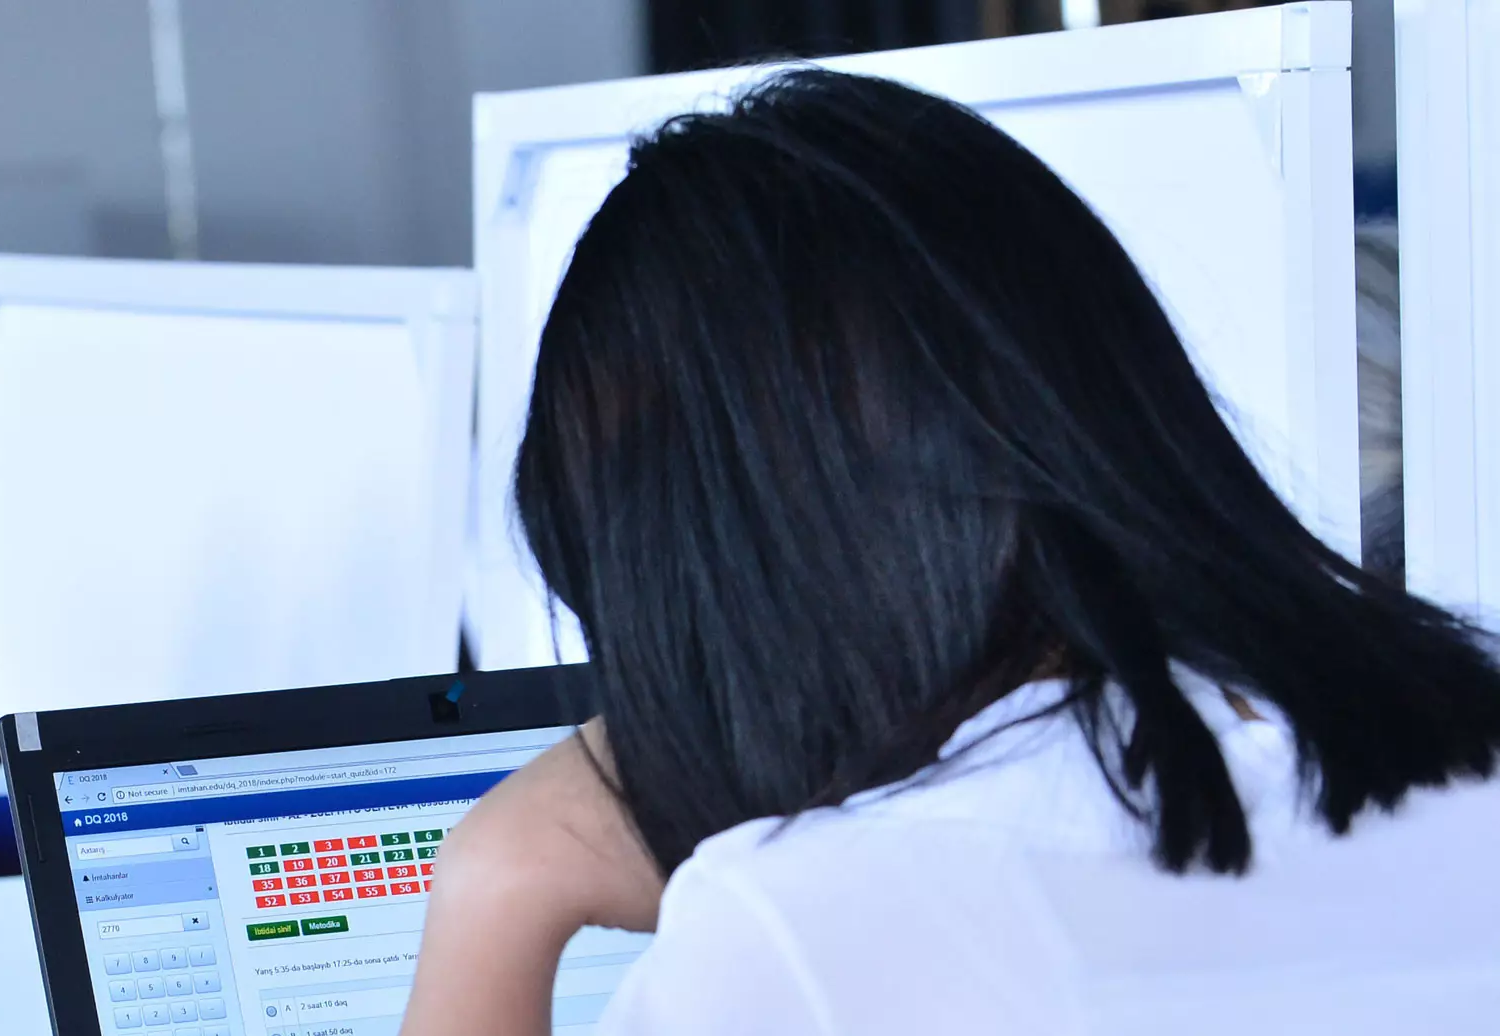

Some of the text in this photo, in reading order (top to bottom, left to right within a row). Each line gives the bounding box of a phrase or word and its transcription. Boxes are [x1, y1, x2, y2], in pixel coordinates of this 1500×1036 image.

[91, 774, 108, 782] 2018
[128, 788, 168, 798] Not secure
[84, 812, 128, 824] DQ 2018
[292, 845, 298, 853] 2
[326, 842, 332, 850] 3
[359, 838, 365, 846] 4
[393, 835, 399, 843] 5
[426, 832, 432, 840] 6
[259, 848, 438, 873] 18 19 20 21 22 23
[262, 880, 274, 889] 35
[296, 877, 308, 886] 36
[329, 874, 341, 883] 37
[362, 871, 375, 880] 38
[396, 868, 408, 876] 39
[265, 884, 412, 906] 52 53 54 55 56
[308, 921, 340, 930] Metodika
